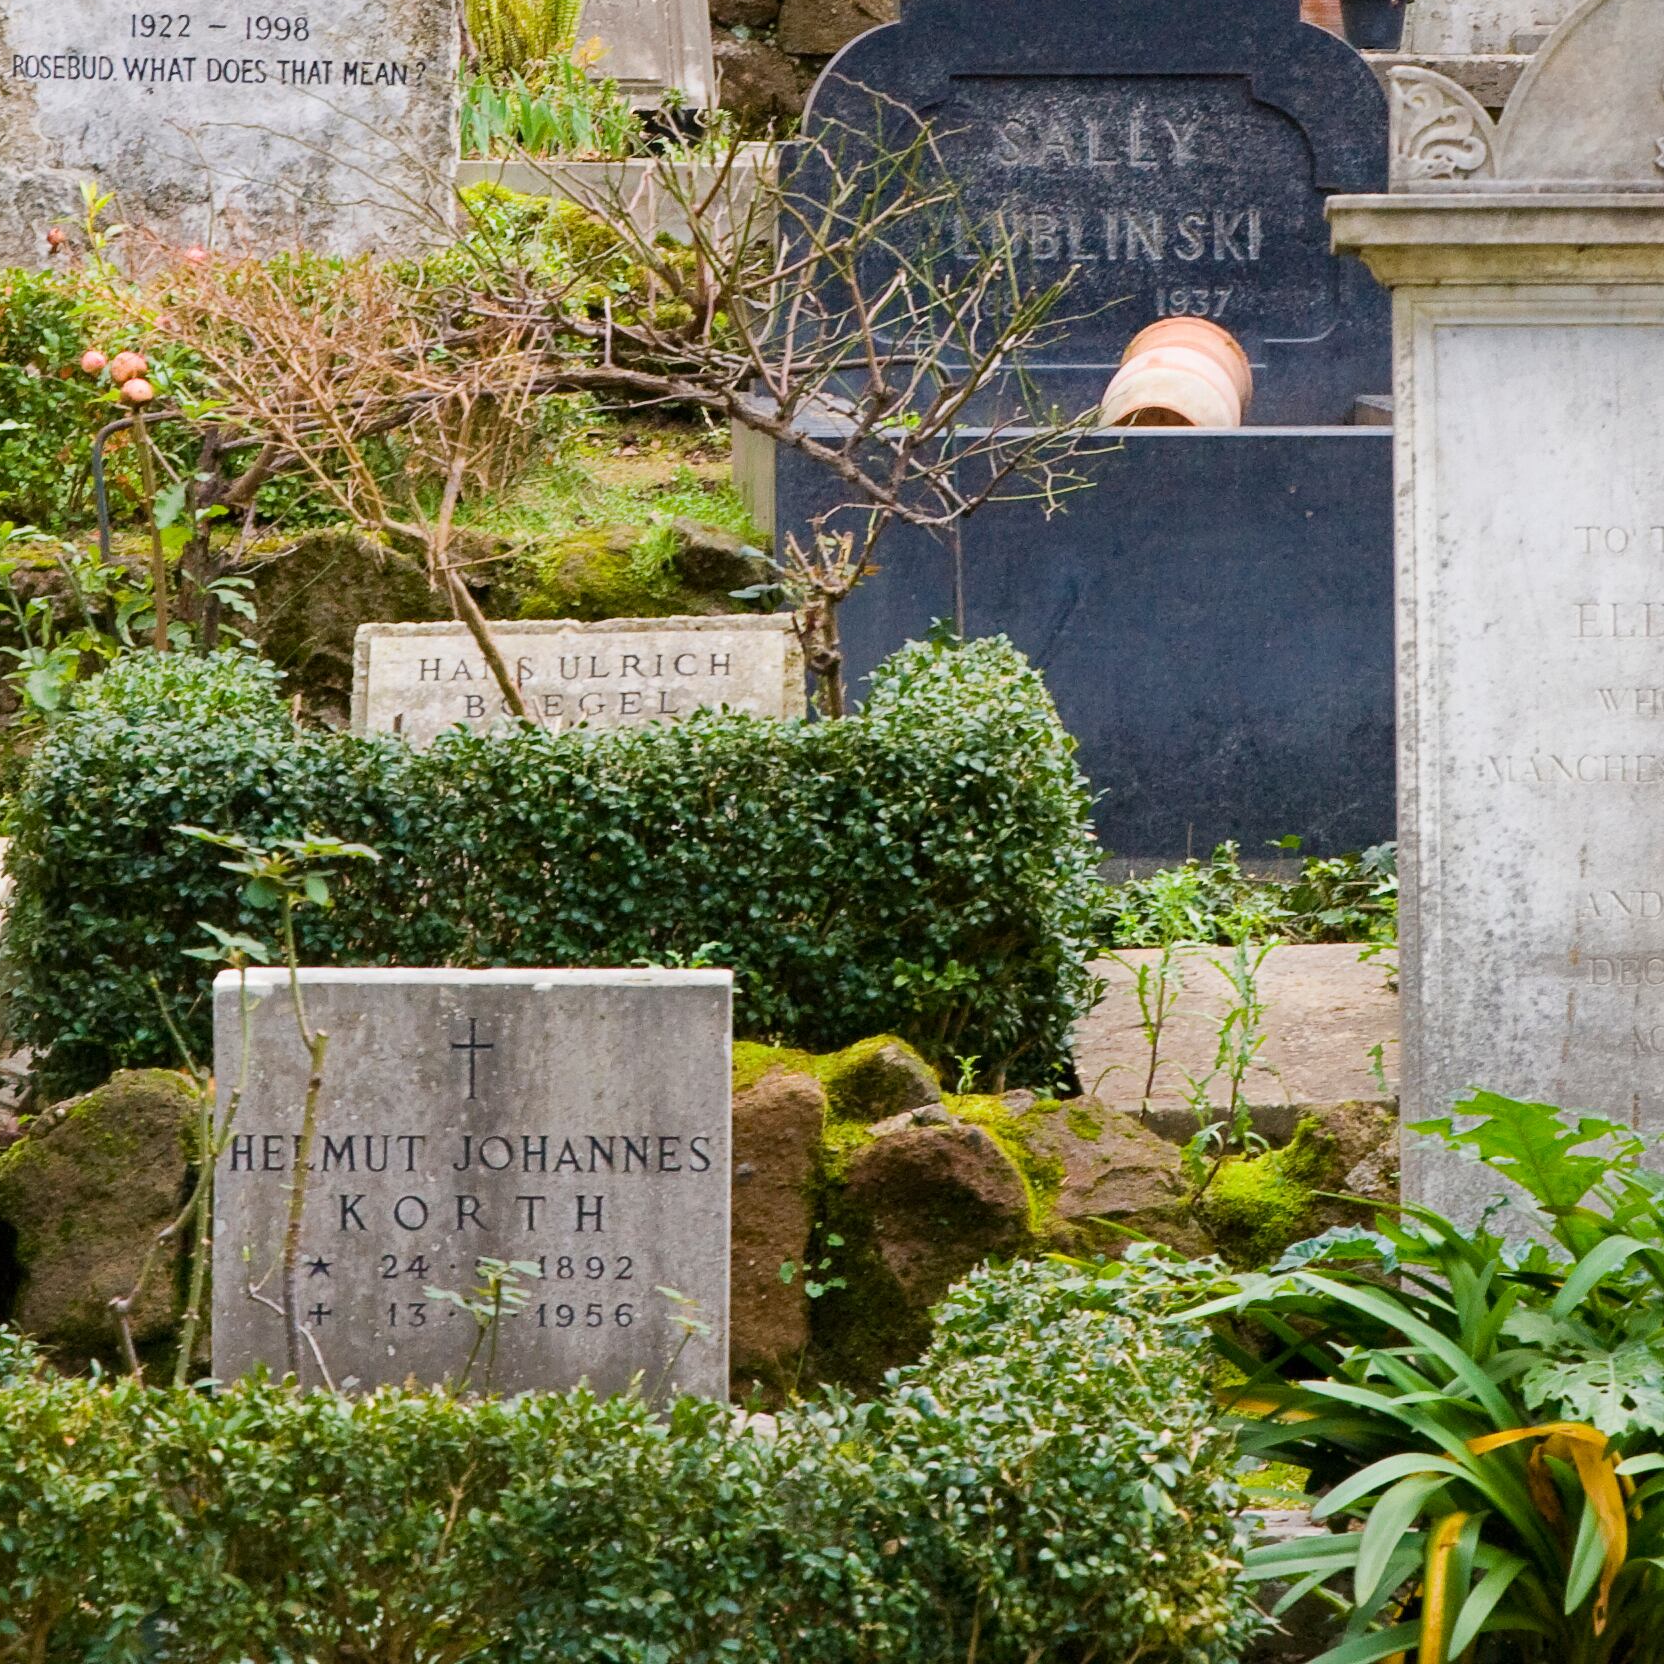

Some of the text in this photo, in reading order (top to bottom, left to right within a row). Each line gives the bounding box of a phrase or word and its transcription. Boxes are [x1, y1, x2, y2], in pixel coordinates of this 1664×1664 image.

[130, 13, 311, 42] 1922 1998
[123, 55, 197, 84] WHAT
[206, 57, 267, 85] DOES
[276, 59, 334, 86] THAT
[998, 118, 1203, 168] SALLY
[954, 208, 1263, 262] LUBLINSKI
[1156, 286, 1233, 318] 1937
[1573, 525, 1632, 555] TO
[558, 653, 733, 681] ULRICH
[229, 1134, 713, 1174] HELMUT JOHANNES
[339, 1194, 606, 1233] KORTH
[381, 1254, 635, 1280] 24 1892
[388, 1302, 635, 1328] 13 1956
